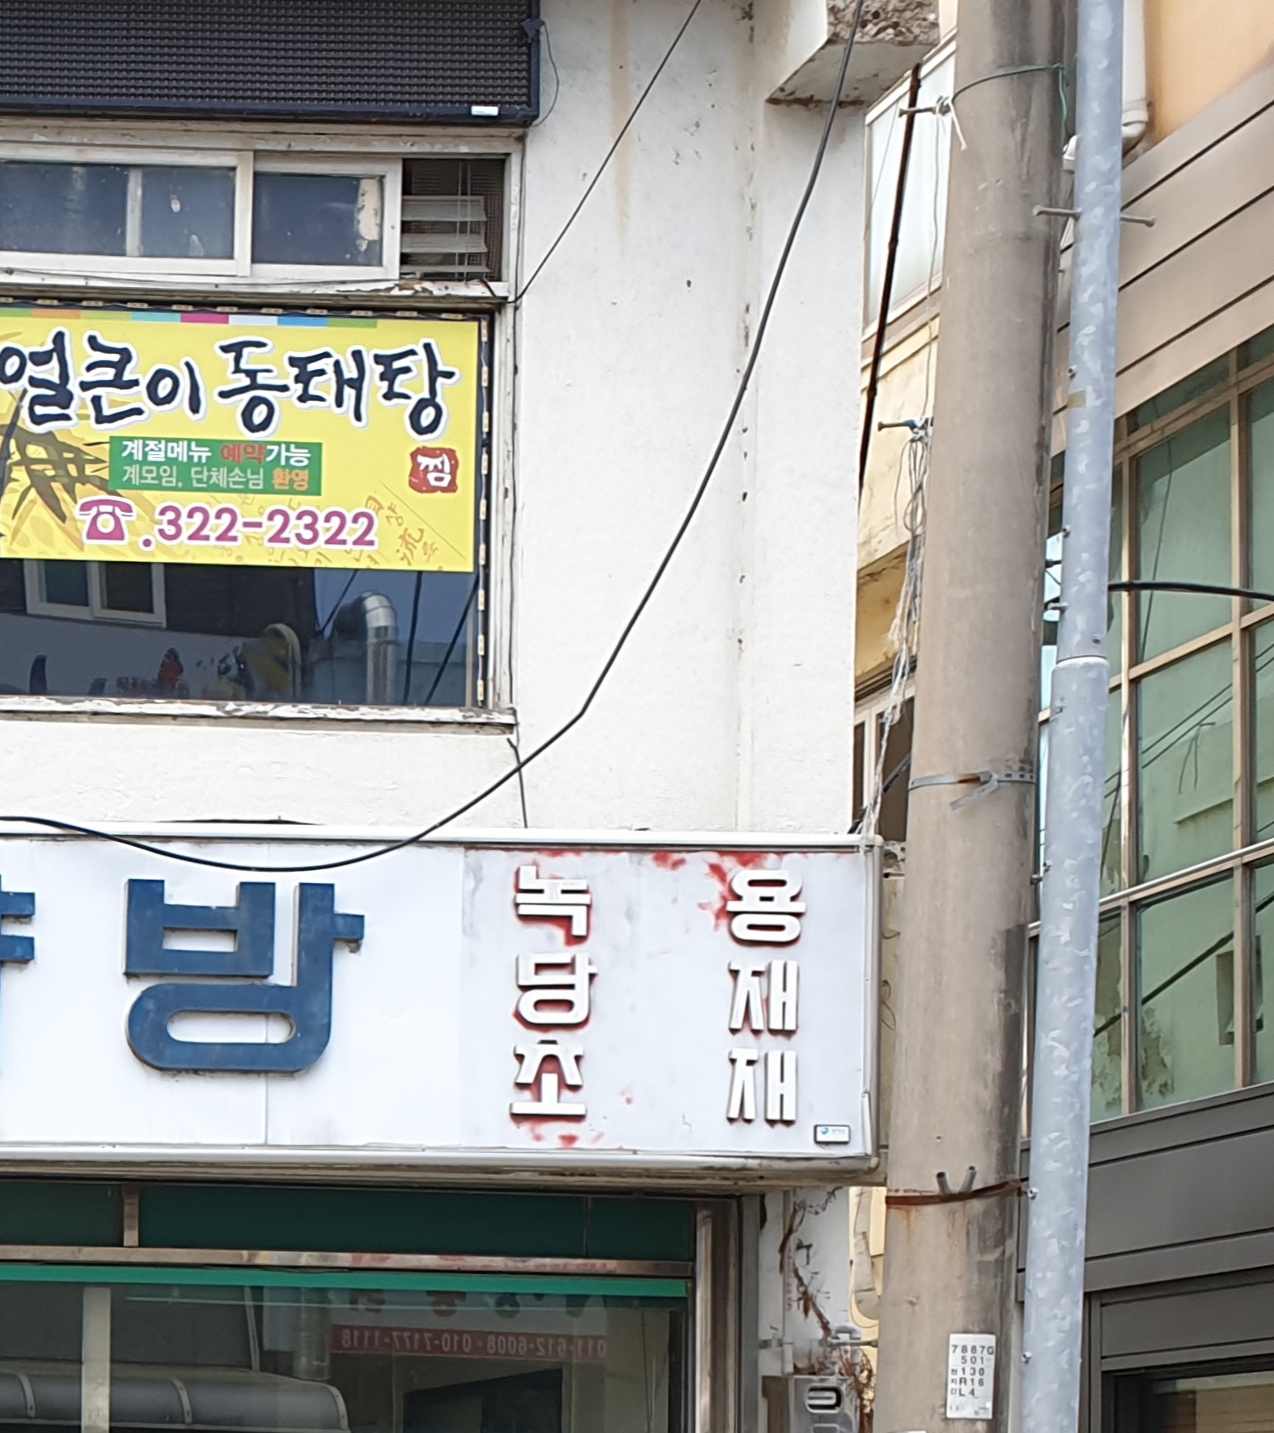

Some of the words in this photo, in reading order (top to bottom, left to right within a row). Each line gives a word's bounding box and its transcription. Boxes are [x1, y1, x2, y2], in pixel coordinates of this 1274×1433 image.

[217, 339, 456, 436] 동태탕
[121, 439, 212, 463] 계절메뉴
[220, 443, 312, 467] 예약가능
[122, 465, 183, 488] 계모임,
[190, 466, 264, 489] 단체손님
[271, 467, 310, 491] 환영
[416, 453, 452, 488] 찜
[960, 1355, 985, 1366] 501
[960, 1366, 985, 1377] 130
